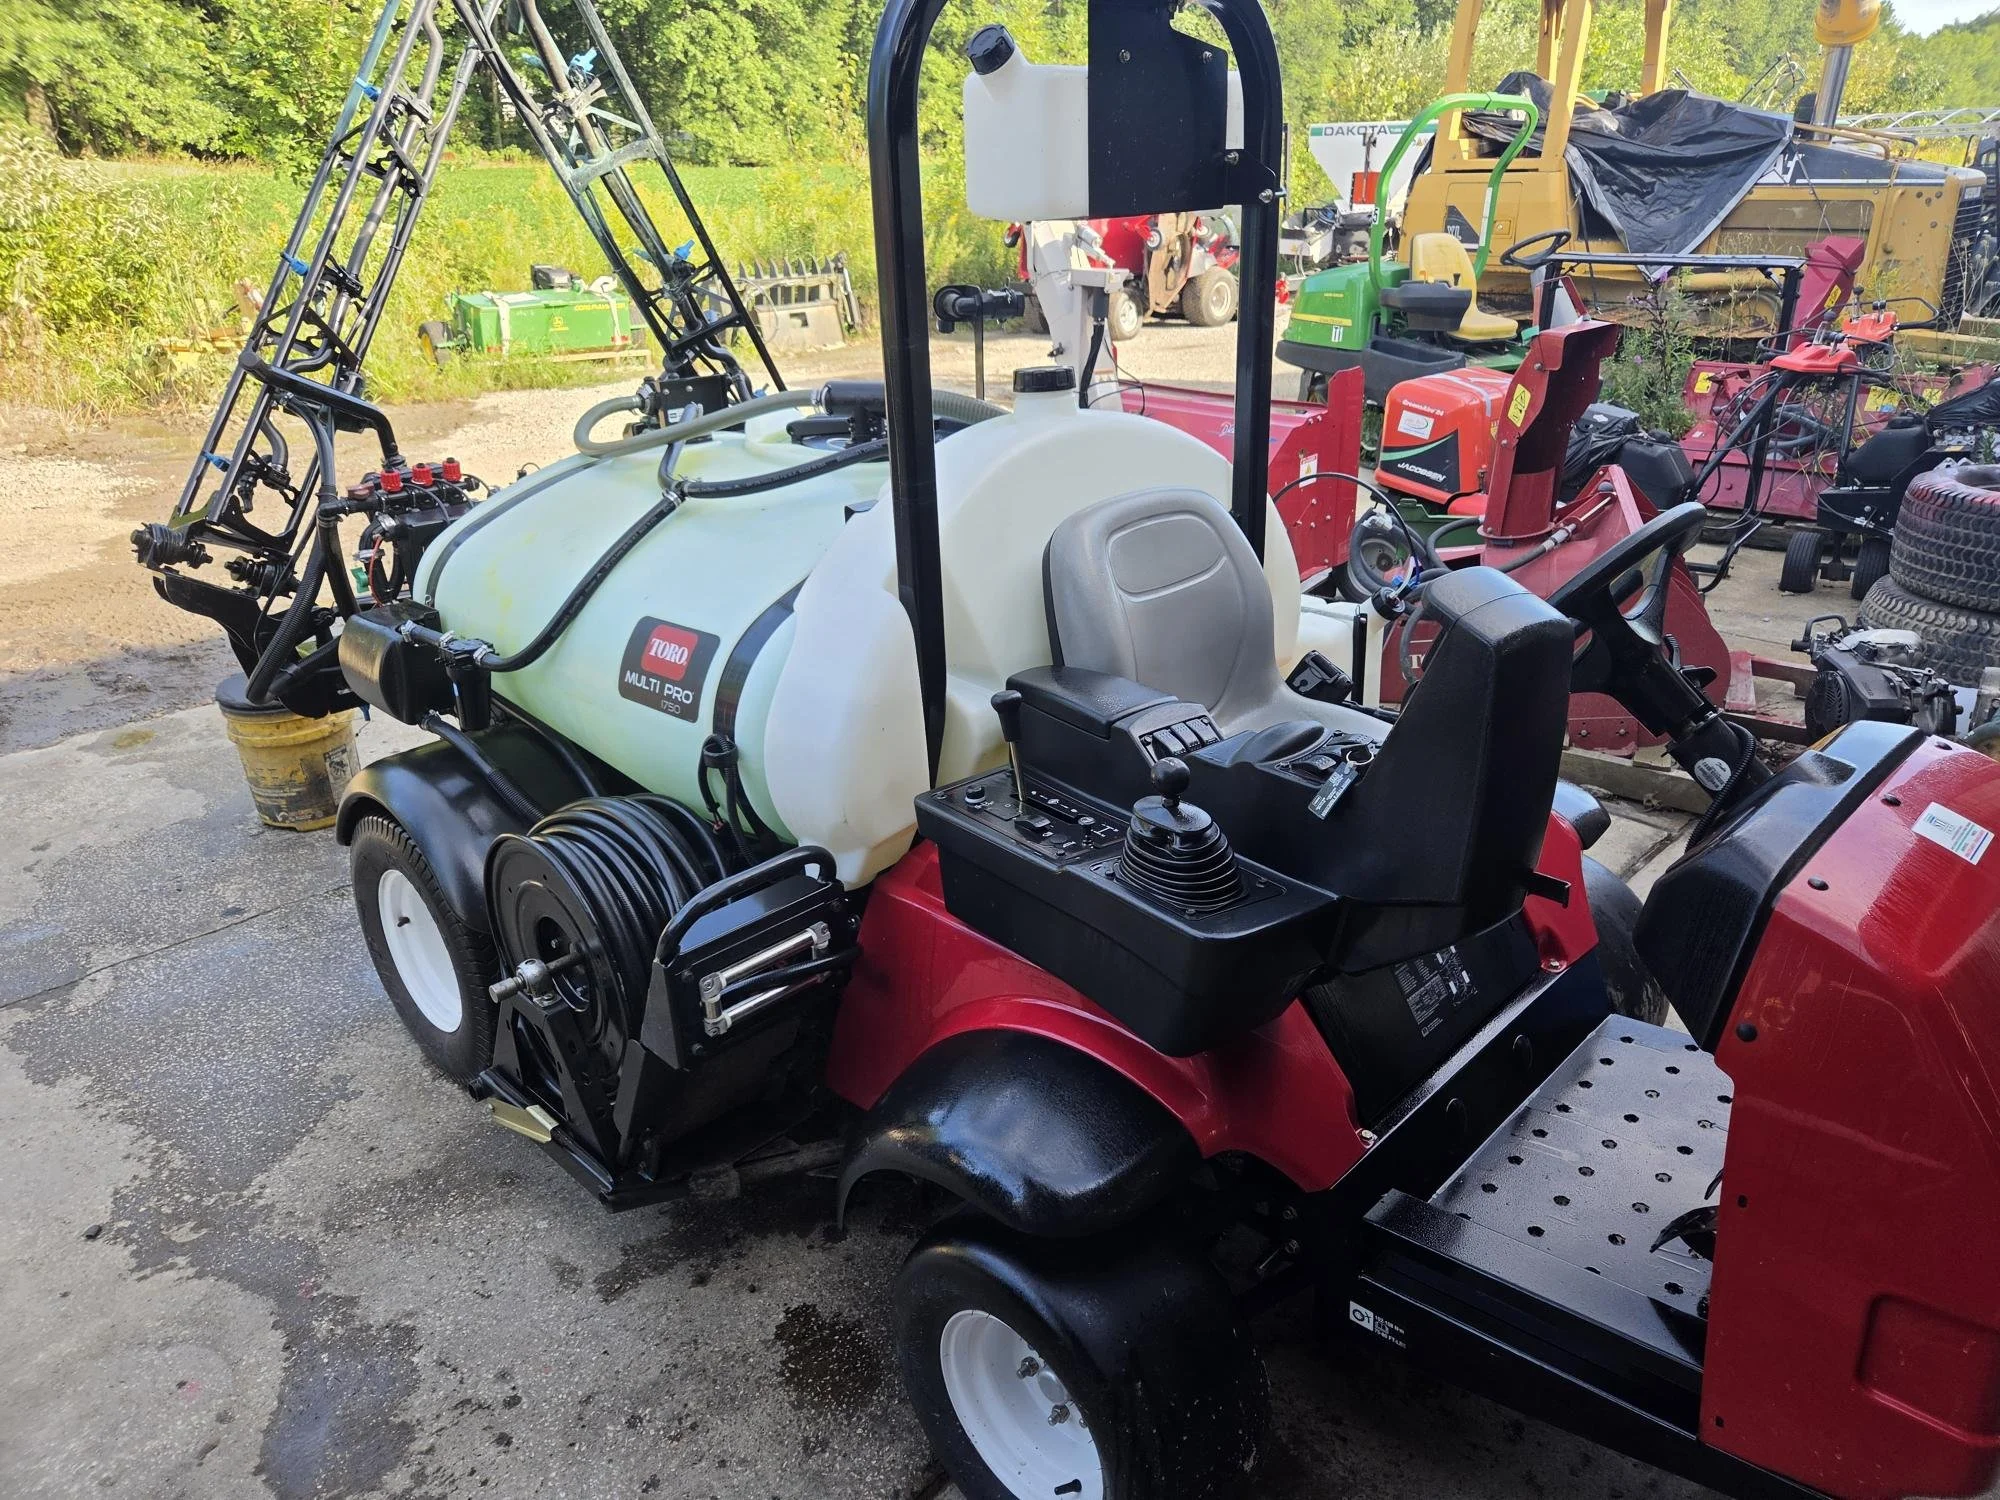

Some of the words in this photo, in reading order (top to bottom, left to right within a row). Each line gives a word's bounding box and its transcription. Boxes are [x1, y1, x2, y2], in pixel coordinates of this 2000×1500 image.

[1324, 125, 1388, 136] DAKOTA
[1397, 462, 1447, 483] JACOBSEN
[648, 638, 689, 665] TORO
[624, 670, 660, 694] MULTI
[663, 683, 694, 704] PRO
[660, 700, 681, 714] 1750
